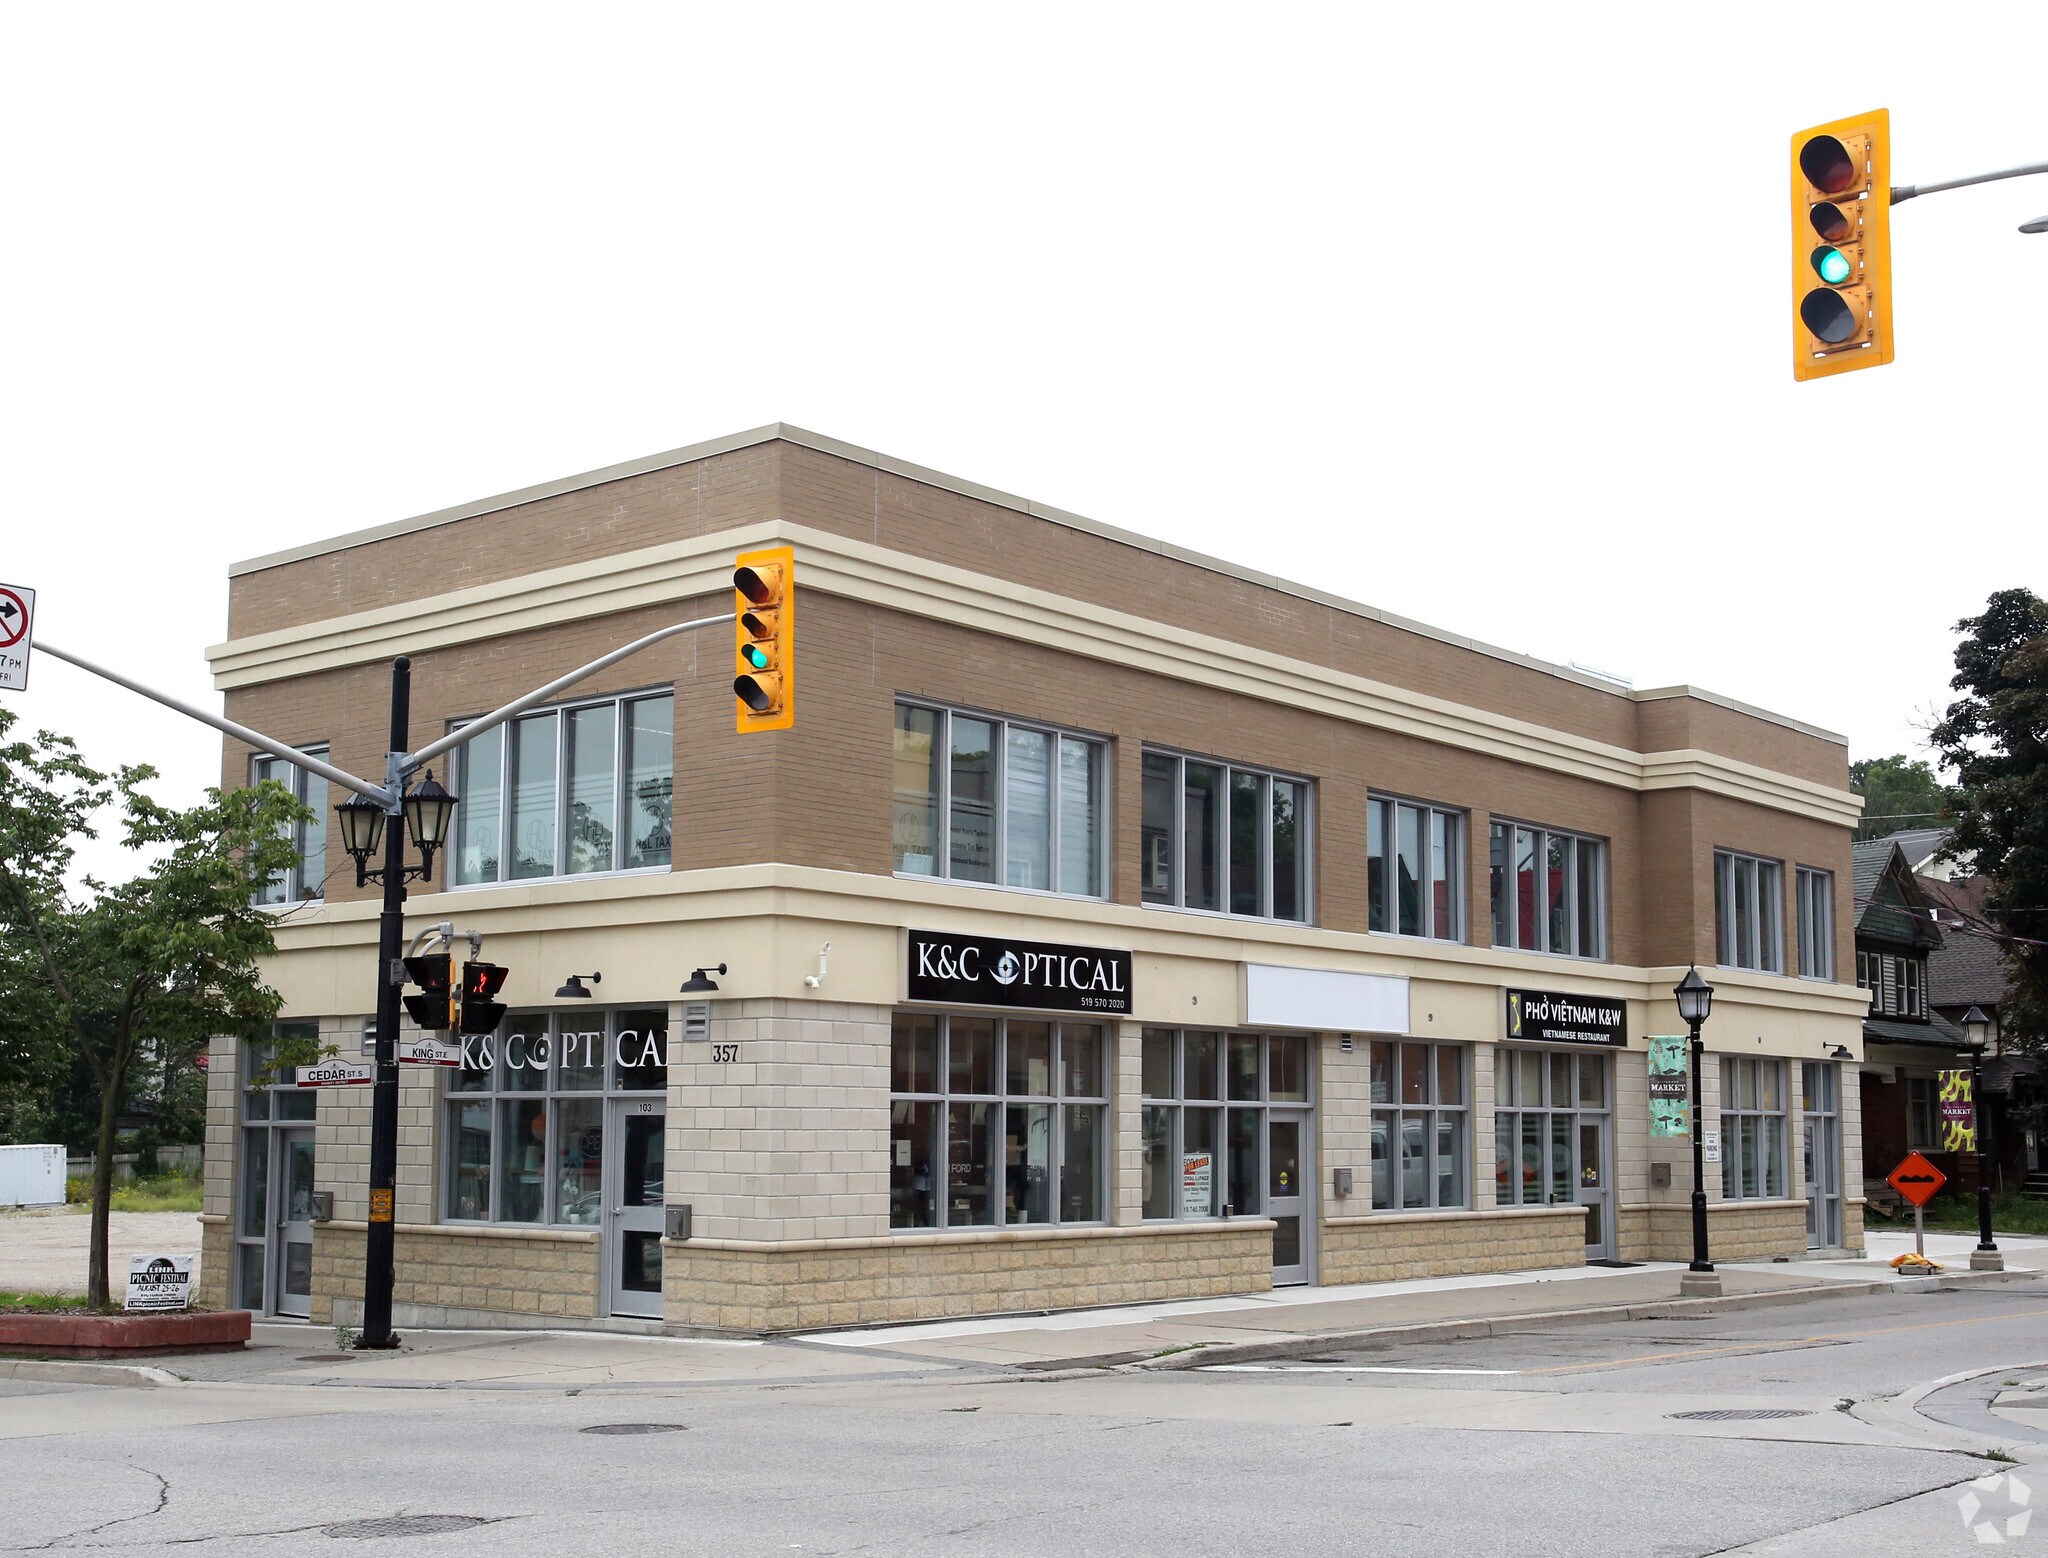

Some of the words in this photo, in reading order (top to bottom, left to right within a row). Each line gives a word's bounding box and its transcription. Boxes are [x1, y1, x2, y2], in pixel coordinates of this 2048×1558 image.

[9, 658, 21, 669] PM
[656, 835, 671, 849] TAX
[917, 942, 979, 982] K&C
[1081, 997, 1093, 1007] 519
[1095, 998, 1107, 1008] 570
[1109, 999, 1125, 1009] 2020
[1525, 995, 1549, 1021] PHỞ
[1598, 1008, 1621, 1026] K&W
[1542, 1029, 1576, 1040] VIETNAMESE
[1577, 1032, 1610, 1042] RESTAURANT
[412, 1047, 434, 1059] KING
[713, 1045, 739, 1062] 357
[308, 1069, 346, 1081] CEDAR
[1651, 1083, 1686, 1092] MARKET
[639, 1104, 652, 1112] 103
[951, 1163, 972, 1173] FORD
[131, 1274, 159, 1284] PICNIC
[160, 1273, 187, 1283] FESTIVAL
